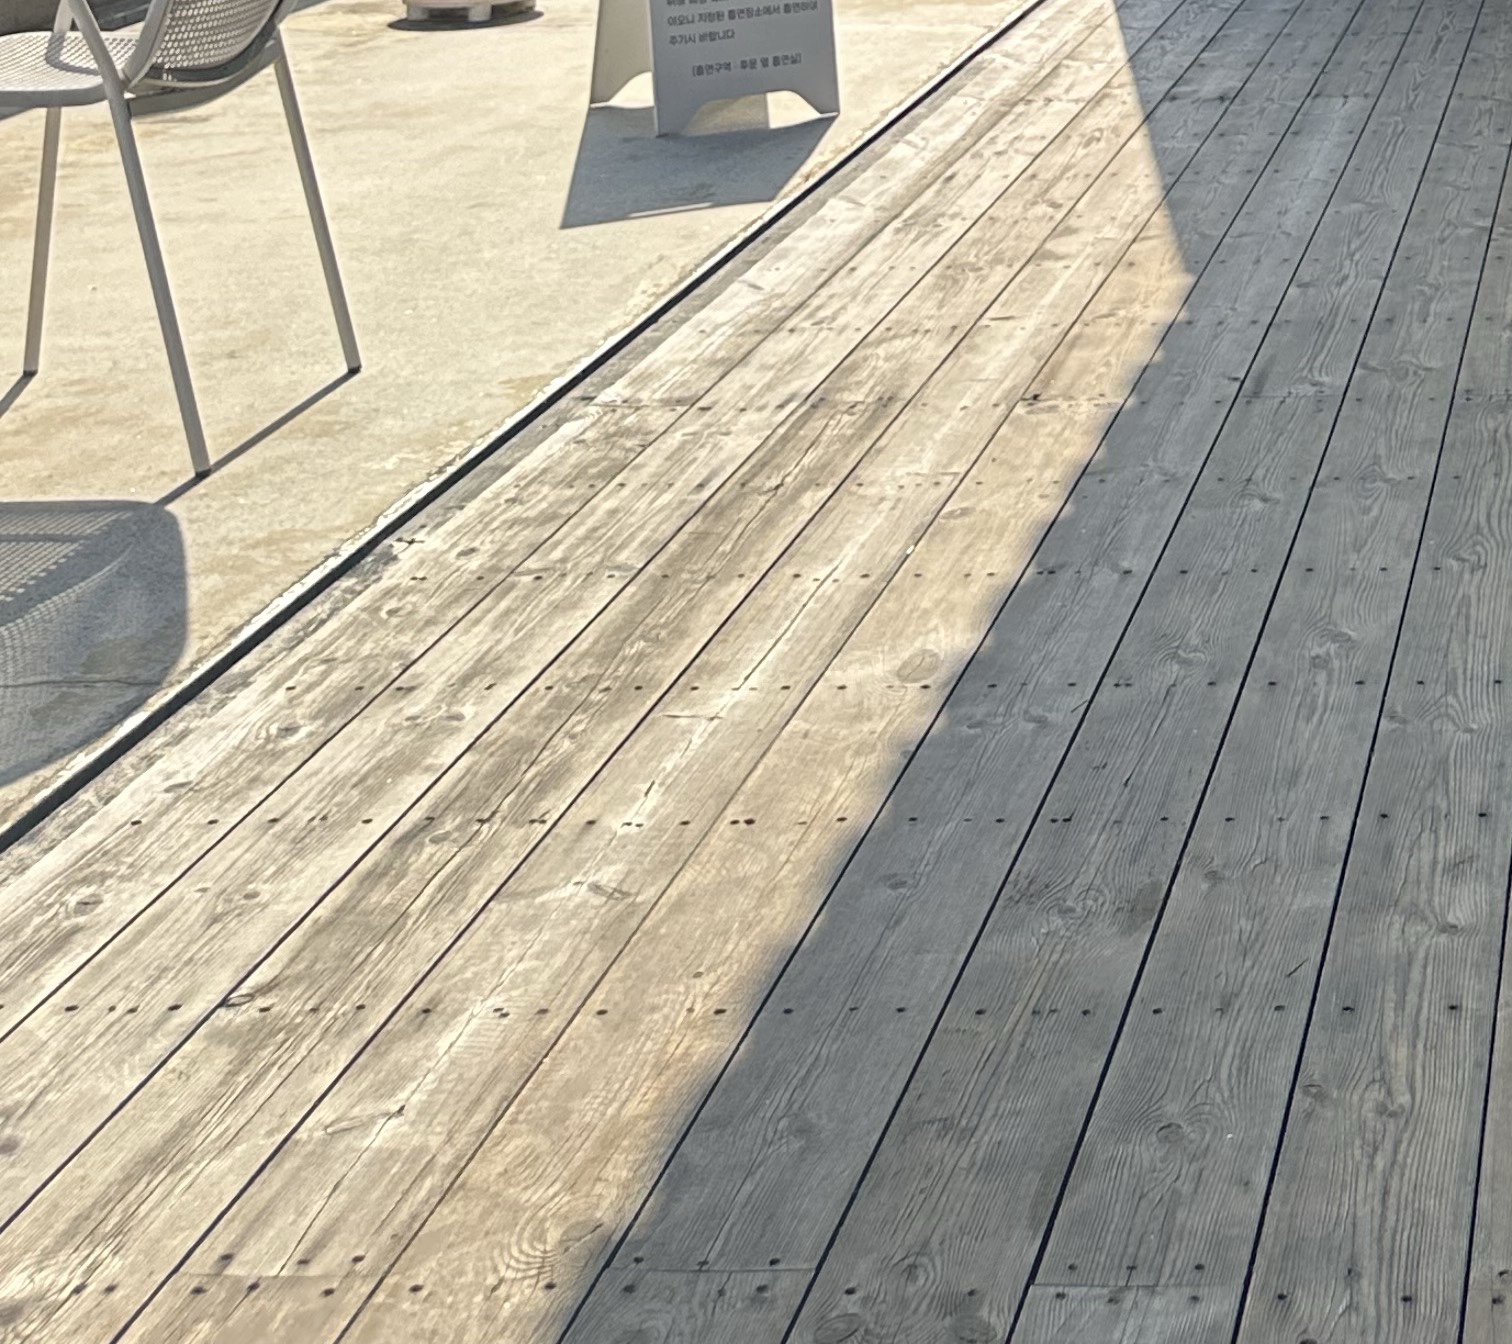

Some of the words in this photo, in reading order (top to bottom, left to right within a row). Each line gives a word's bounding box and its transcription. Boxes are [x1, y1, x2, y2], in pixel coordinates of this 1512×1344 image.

[667, 15, 695, 26] 이오니
[697, 11, 725, 24] 지정된
[727, 5, 781, 20] 흡연장소에서
[699, 29, 735, 43] 바랍니다
